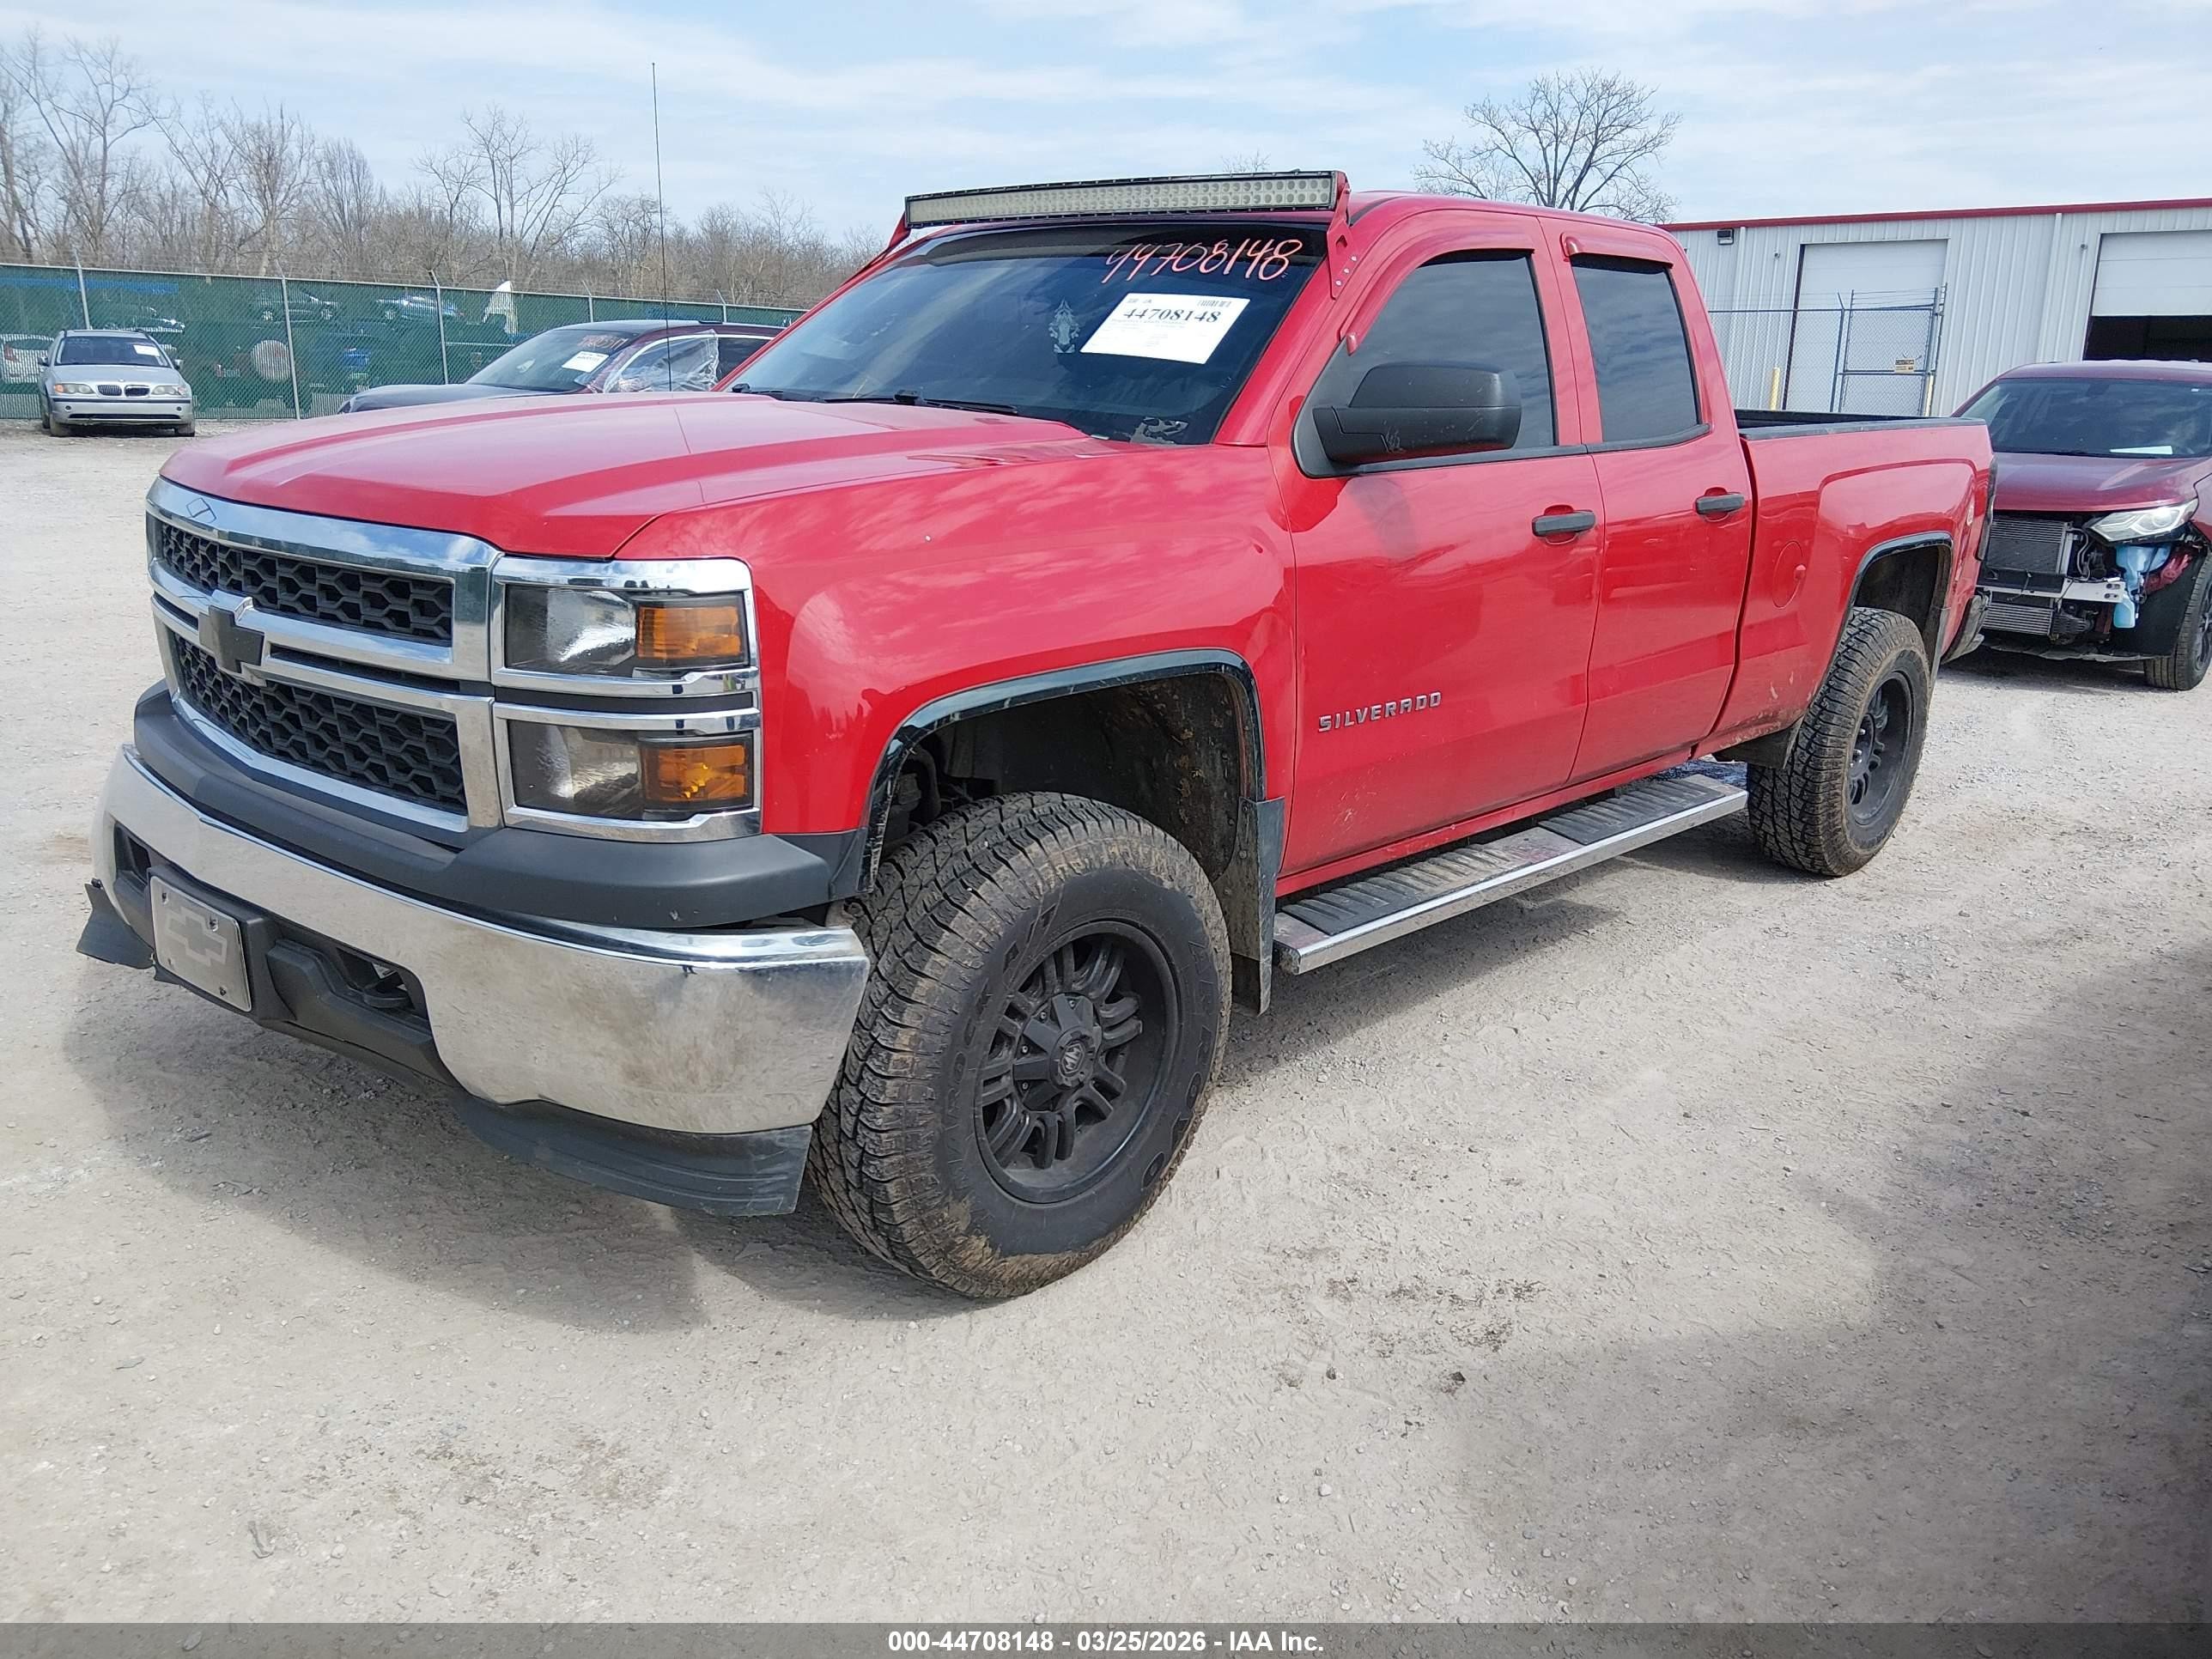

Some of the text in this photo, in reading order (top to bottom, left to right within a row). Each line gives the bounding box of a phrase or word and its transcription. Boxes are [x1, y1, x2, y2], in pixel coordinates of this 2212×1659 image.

[1101, 238, 1304, 284] 44708148
[1123, 307, 1222, 324] 44708148
[1318, 691, 1442, 732] SILVERADO
